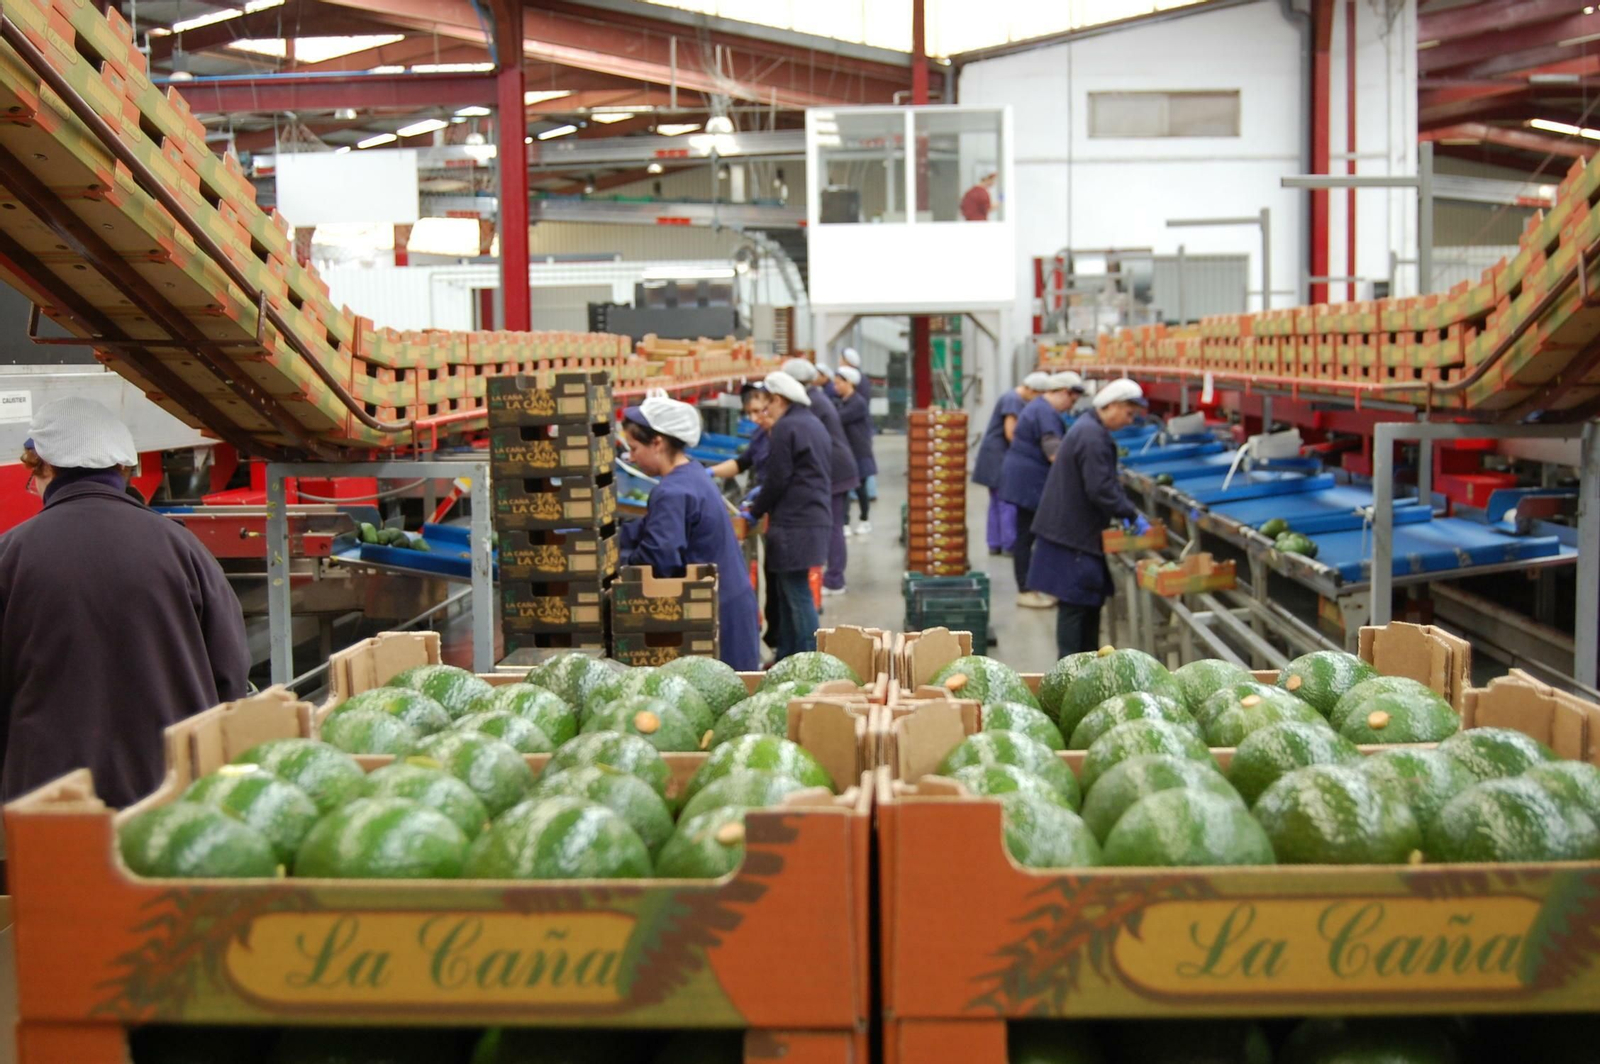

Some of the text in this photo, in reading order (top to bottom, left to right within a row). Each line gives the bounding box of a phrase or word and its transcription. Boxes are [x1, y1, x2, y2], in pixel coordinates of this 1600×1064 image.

[506, 400, 520, 410] LA
[509, 453, 524, 462] LA
[512, 505, 527, 514] LA
[517, 557, 532, 566] LA
[520, 609, 534, 618] LA
[632, 606, 646, 615] LA
[632, 657, 647, 666] LA
[1175, 900, 1526, 980] La Caña
[284, 913, 622, 991] La Caña
